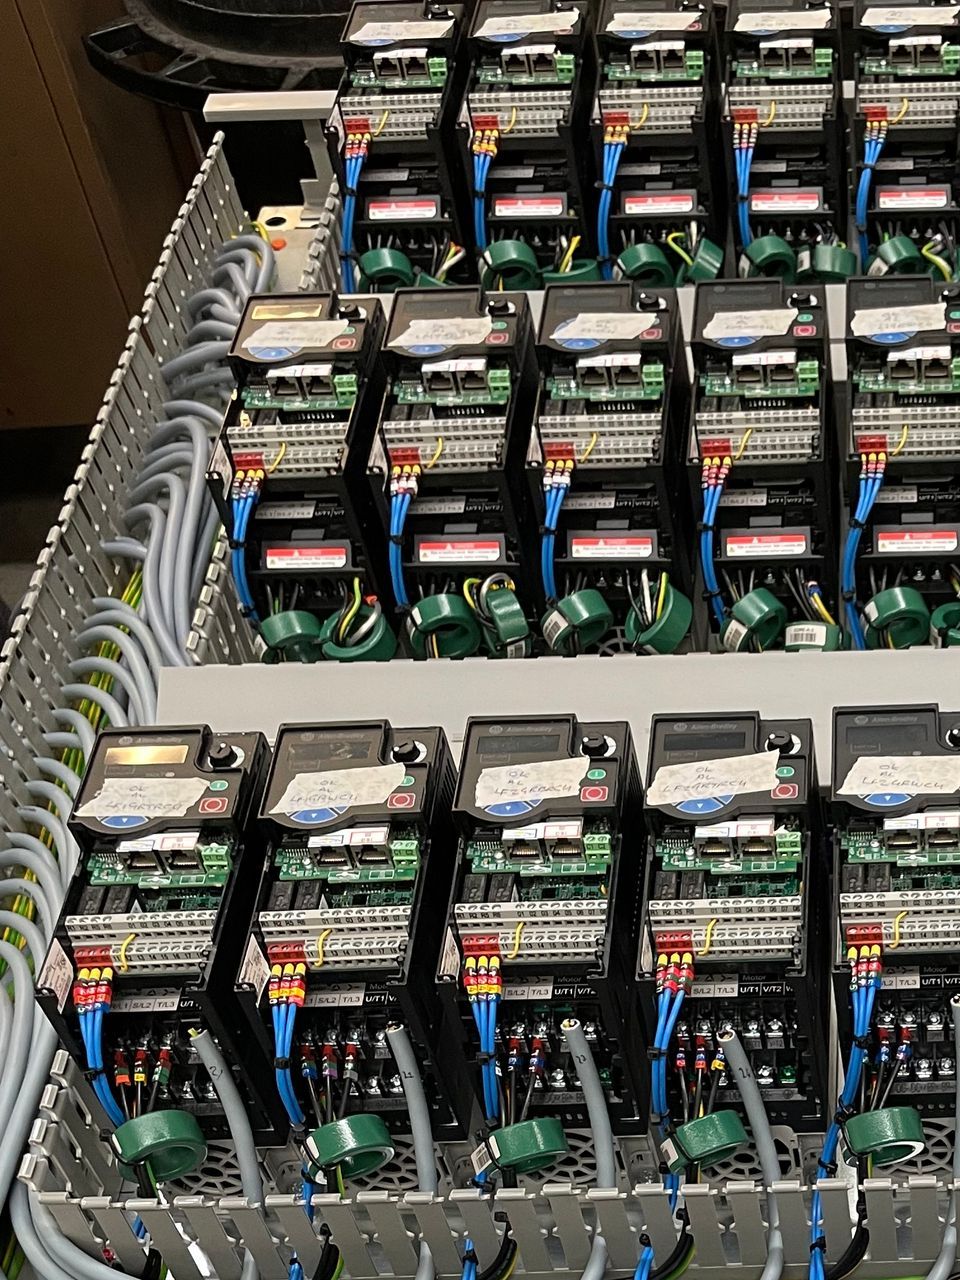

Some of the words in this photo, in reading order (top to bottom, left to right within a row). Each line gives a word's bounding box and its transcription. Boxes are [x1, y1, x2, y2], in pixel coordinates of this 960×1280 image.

[899, 978, 917, 986] T/L3
[922, 978, 941, 986] U/T1
[507, 988, 525, 996] S/L2
[531, 987, 549, 995] T/L3
[554, 988, 573, 996] U/T1
[717, 986, 736, 994] T/L3
[740, 985, 759, 993] U/T1
[343, 995, 361, 1003] T/L3
[365, 995, 384, 1003] U/T1
[158, 1001, 175, 1009] T/L3
